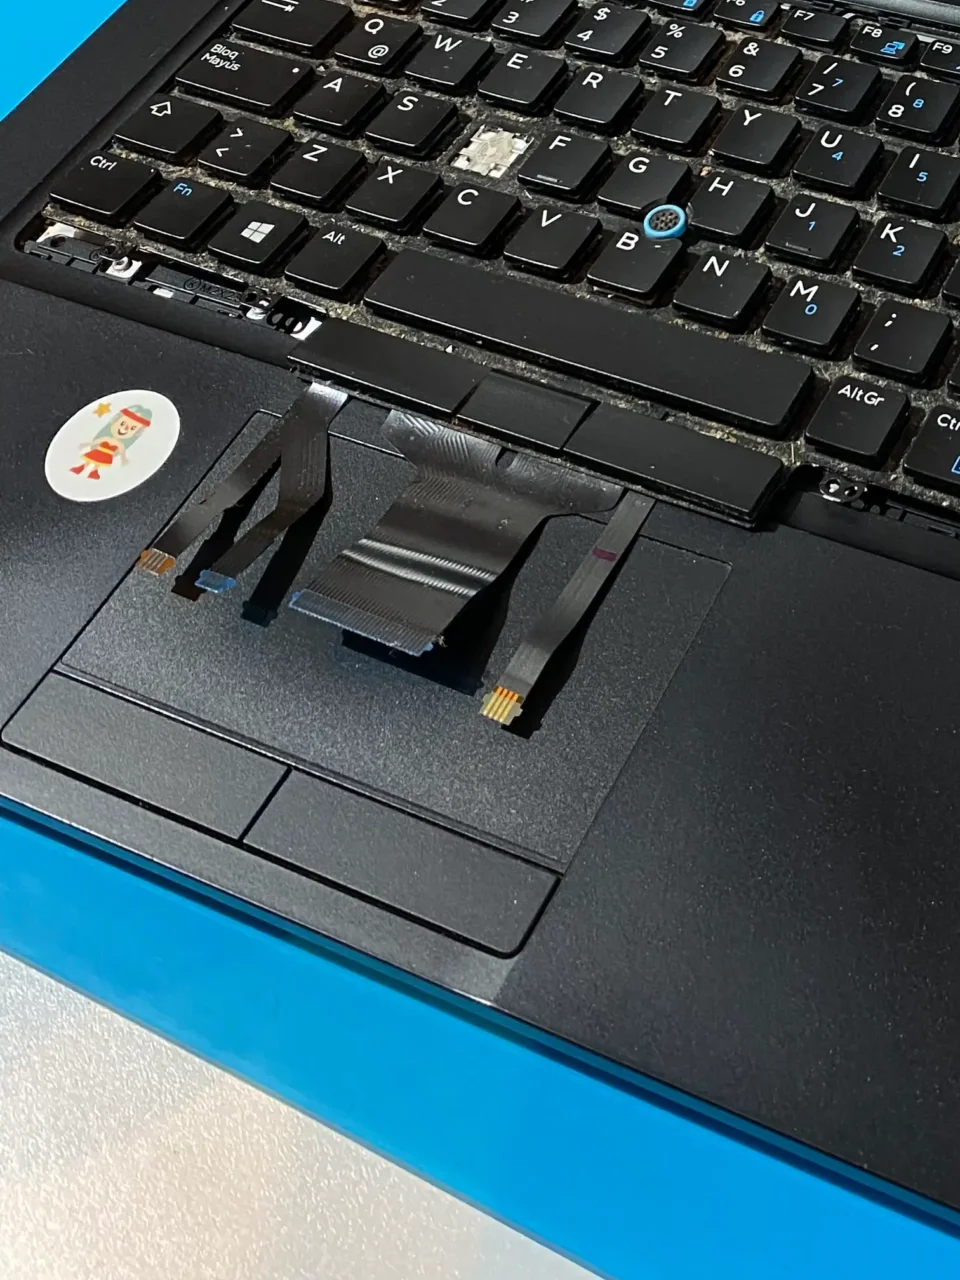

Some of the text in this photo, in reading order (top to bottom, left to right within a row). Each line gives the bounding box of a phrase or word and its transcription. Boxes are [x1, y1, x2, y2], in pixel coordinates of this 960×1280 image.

[502, 11, 520, 24] 3
[593, 7, 611, 21] $
[793, 9, 816, 21] F7
[364, 18, 385, 35] Q
[666, 23, 686, 39] %
[861, 24, 883, 39] F8
[434, 34, 463, 52] W
[576, 29, 594, 42] 4
[207, 43, 239, 63] Bloq
[367, 44, 389, 59] @
[650, 45, 669, 59] 5
[742, 41, 760, 57] &
[932, 41, 953, 54] F9
[200, 49, 241, 71] Mayús
[506, 52, 529, 70] E
[728, 64, 746, 78] 6
[322, 77, 343, 93] A
[581, 71, 604, 89] R
[832, 78, 844, 87] 7
[807, 83, 825, 96] 7
[905, 81, 917, 97] (
[396, 95, 419, 111] S
[664, 89, 683, 106] T
[912, 98, 925, 109] 8
[743, 109, 763, 126] Y
[887, 104, 905, 118] 8
[229, 127, 244, 138] >
[820, 130, 843, 148] U
[548, 135, 572, 150] F
[215, 147, 230, 158] <
[302, 144, 328, 162] Z
[831, 151, 844, 161] 4
[90, 155, 118, 171] Ctrl
[628, 156, 650, 174] G
[376, 165, 404, 185] X
[916, 171, 929, 182] 5
[173, 182, 193, 196] Fn
[708, 176, 735, 197] H
[457, 188, 479, 206] C
[795, 202, 816, 218] J
[541, 209, 562, 228] V
[808, 221, 816, 231] 1
[321, 230, 346, 245] Alt
[880, 222, 905, 243] K
[615, 231, 640, 251] B
[892, 245, 905, 257] 2
[702, 255, 730, 277] N
[789, 280, 819, 302] M
